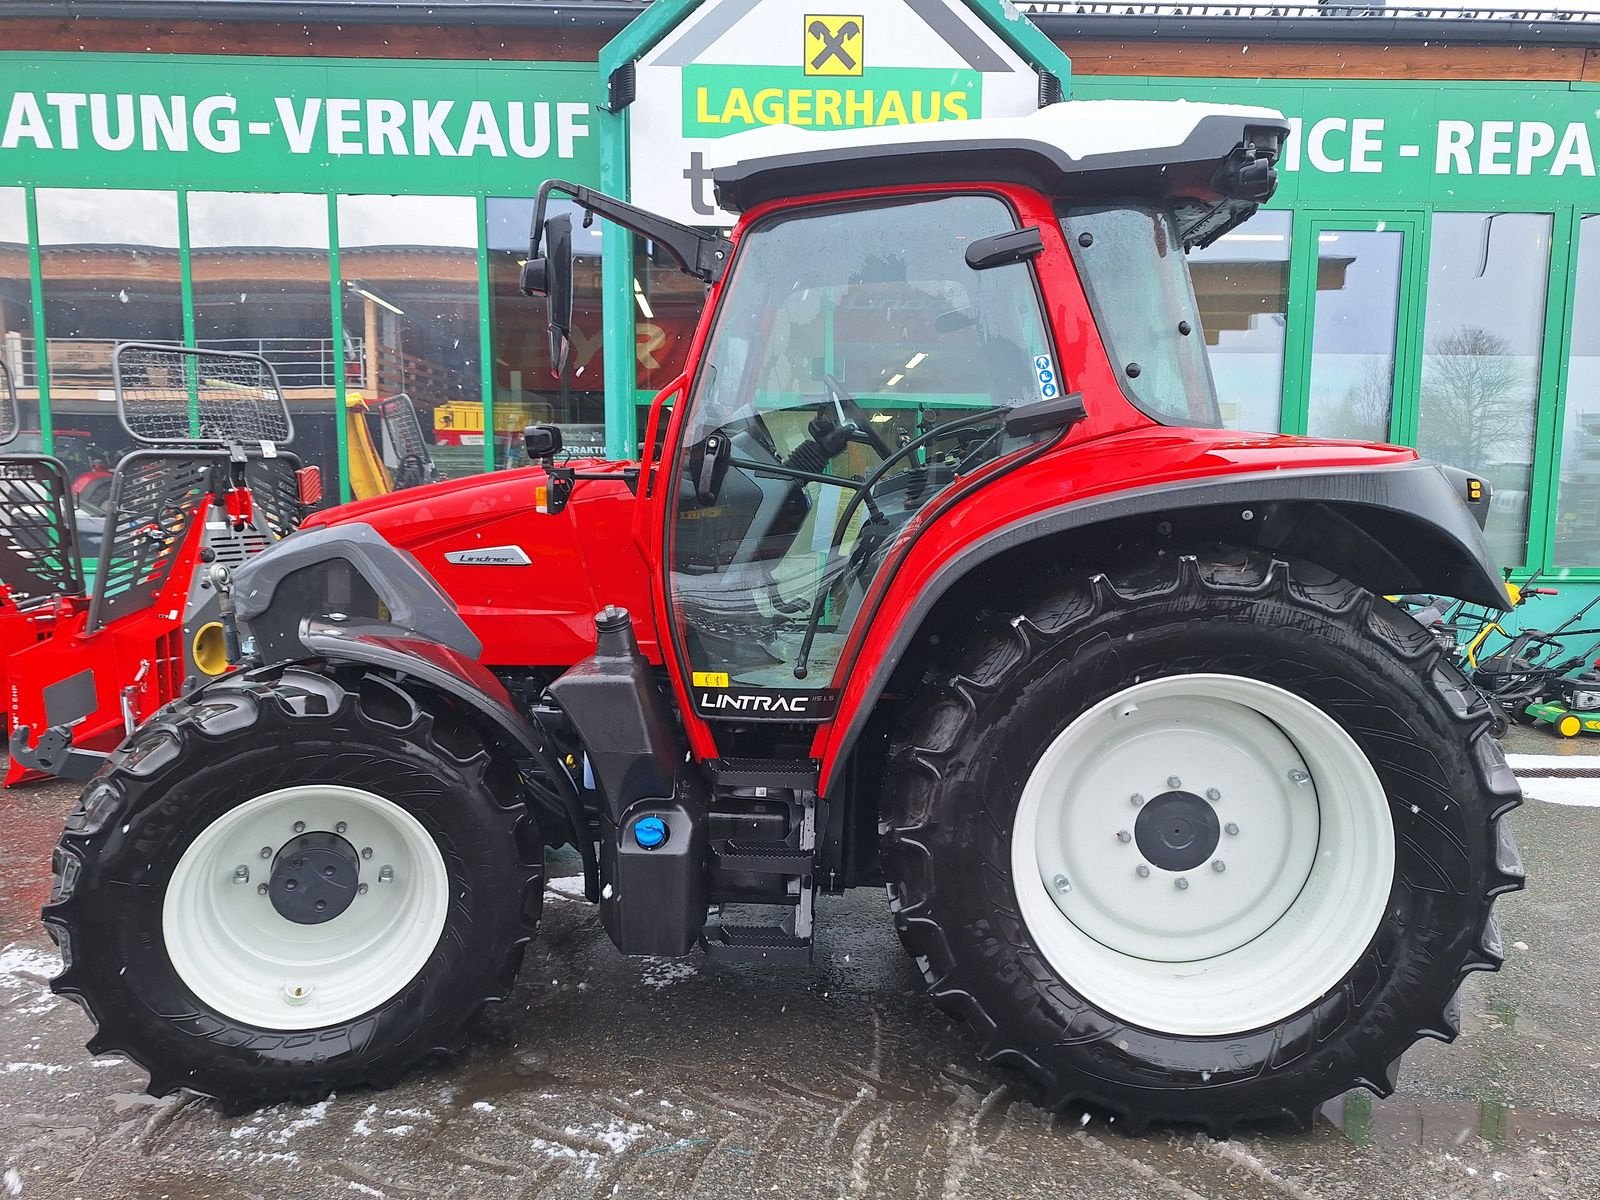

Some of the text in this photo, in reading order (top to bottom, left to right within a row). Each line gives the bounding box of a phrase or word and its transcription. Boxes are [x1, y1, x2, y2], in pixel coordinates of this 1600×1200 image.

[697, 87, 968, 126] LAGERHAUS
[1435, 120, 1596, 176] REPA
[459, 554, 515, 562] Lindner
[701, 693, 809, 711] LINTRAC
